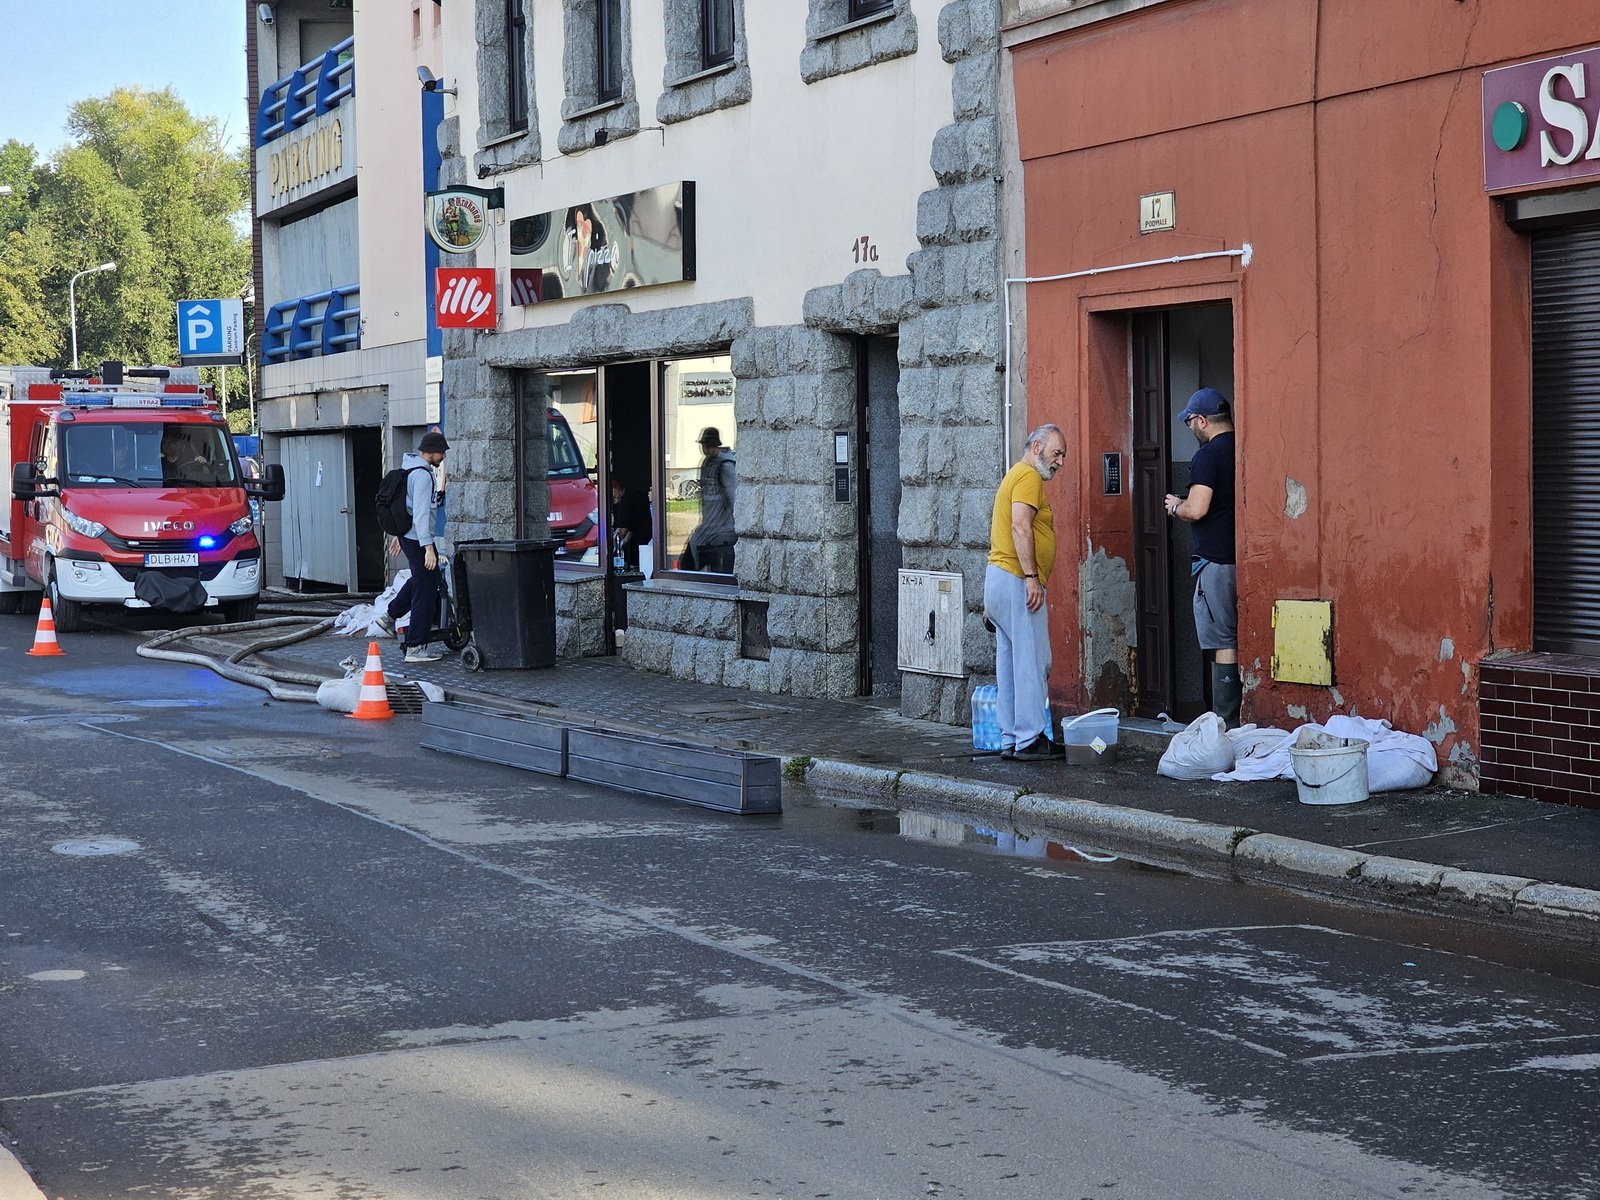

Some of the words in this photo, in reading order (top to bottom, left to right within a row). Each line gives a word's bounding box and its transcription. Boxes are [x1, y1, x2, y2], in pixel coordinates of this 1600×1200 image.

[1538, 62, 1600, 168] S
[270, 118, 342, 198] PARKING
[1151, 198, 1162, 219] 17
[852, 235, 879, 264] 17a
[439, 276, 492, 323] illy
[187, 318, 214, 351] P
[143, 521, 195, 532] IVECO
[150, 554, 171, 565] DLB
[173, 554, 196, 564] HA71
